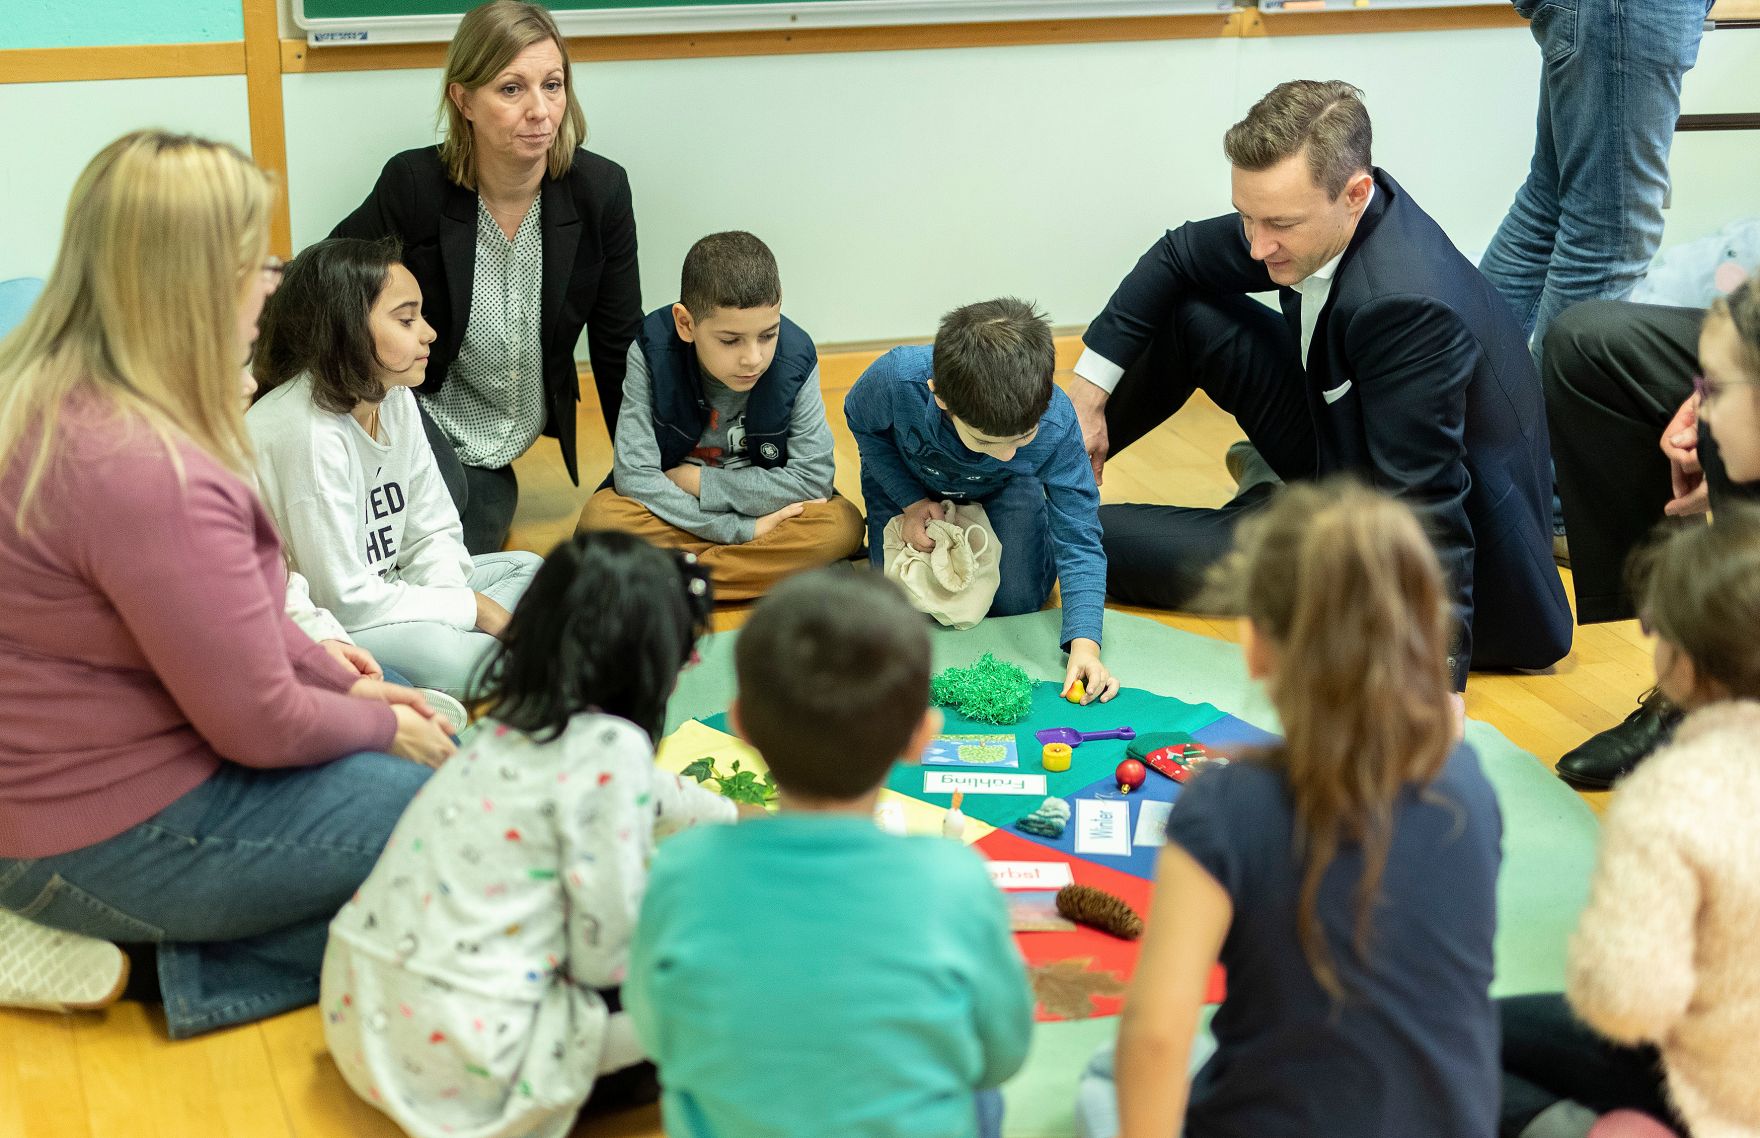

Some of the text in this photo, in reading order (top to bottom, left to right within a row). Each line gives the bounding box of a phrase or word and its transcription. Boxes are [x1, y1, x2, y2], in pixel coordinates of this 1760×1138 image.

[366, 482, 405, 524] ED
[941, 774, 1025, 790] Frühling
[1089, 810, 1113, 839] Winter
[989, 867, 1041, 879] erbst
